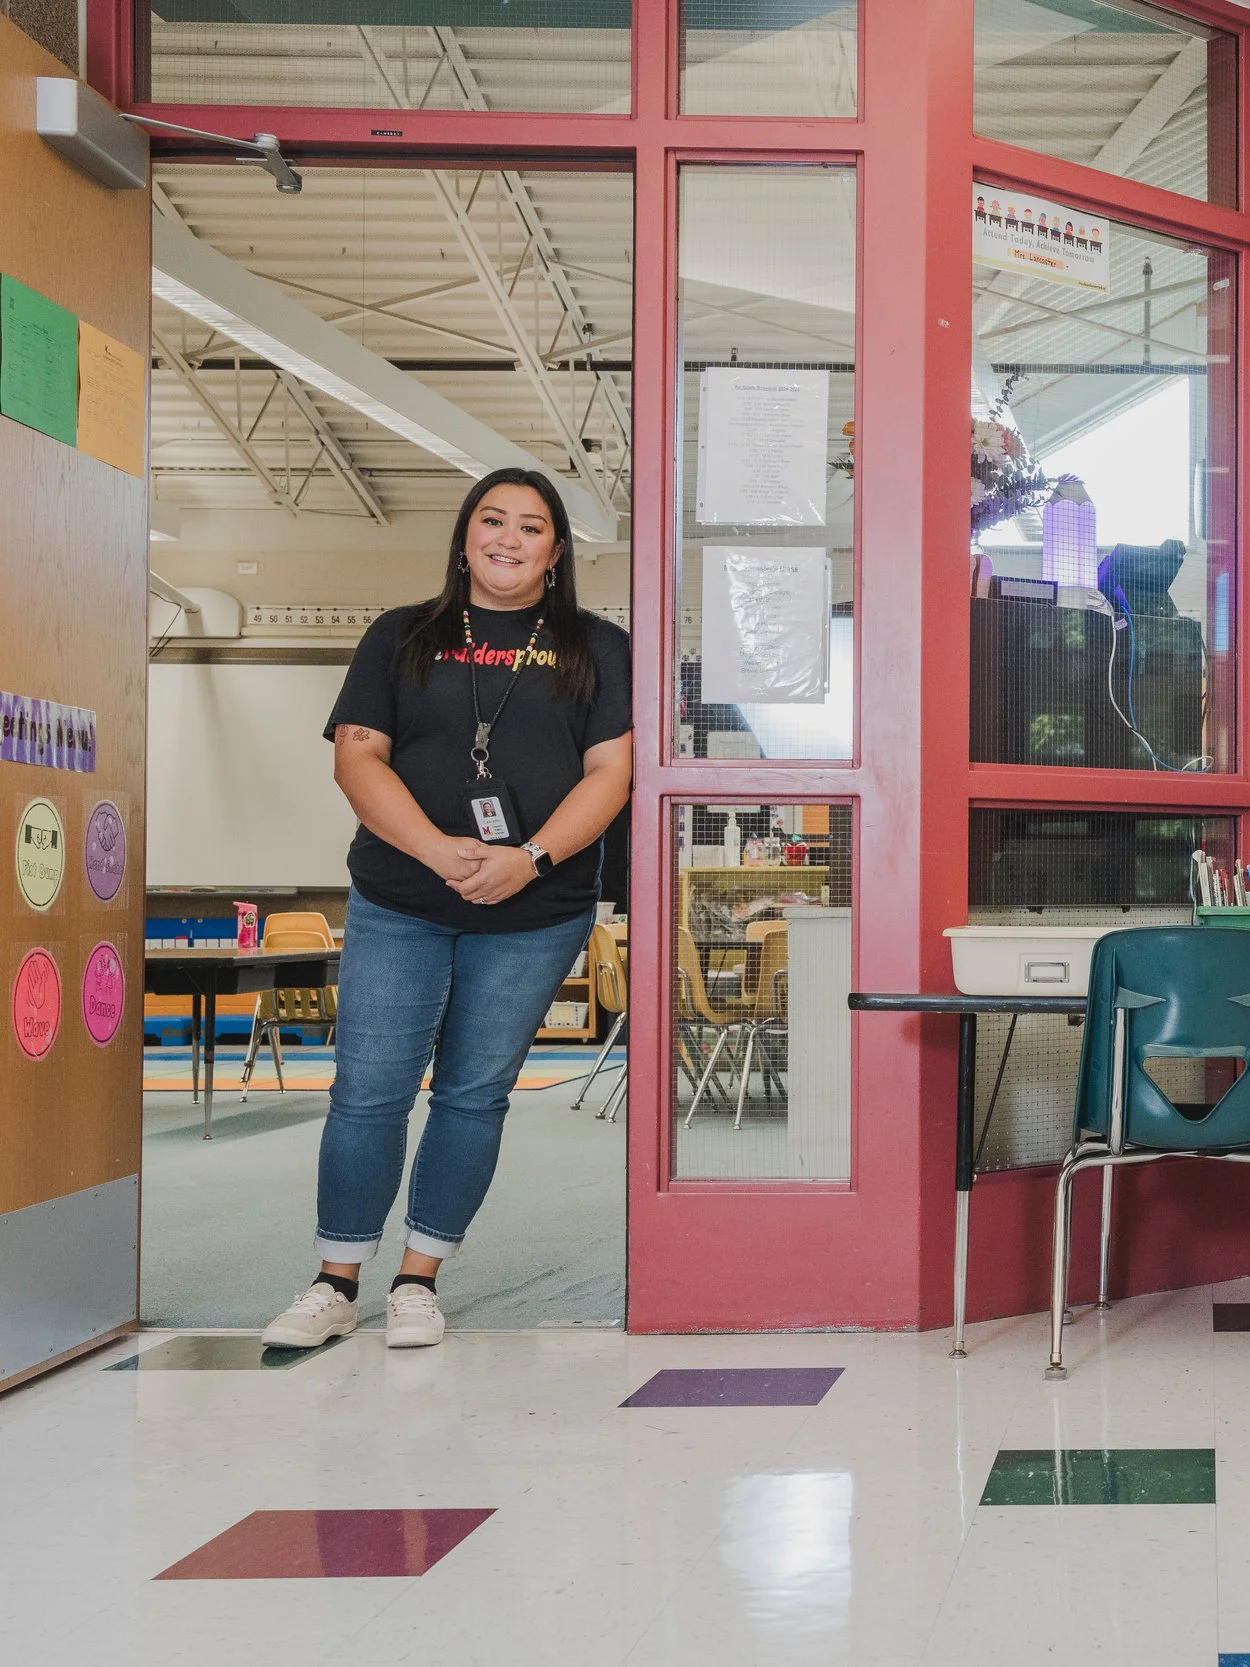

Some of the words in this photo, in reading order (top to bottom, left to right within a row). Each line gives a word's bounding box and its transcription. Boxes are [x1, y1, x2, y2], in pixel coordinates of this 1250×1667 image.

[983, 228, 1008, 241] Attend
[1010, 233, 1035, 249] Today,
[1036, 241, 1061, 256] Achieve
[1062, 247, 1095, 264] Tomorrow
[254, 614, 262, 623] 49
[269, 615, 278, 623] 50
[285, 615, 293, 623] 51
[300, 616, 308, 624] 52
[315, 616, 324, 624] 53
[331, 616, 340, 624] 54
[347, 616, 356, 624] 55
[363, 616, 372, 624] 56
[616, 615, 625, 624] 72
[684, 616, 693, 624] 76
[22, 859, 37, 878] Fist
[39, 863, 59, 888] Bump
[88, 994, 116, 1019] Dance
[23, 1016, 50, 1038] Wave
